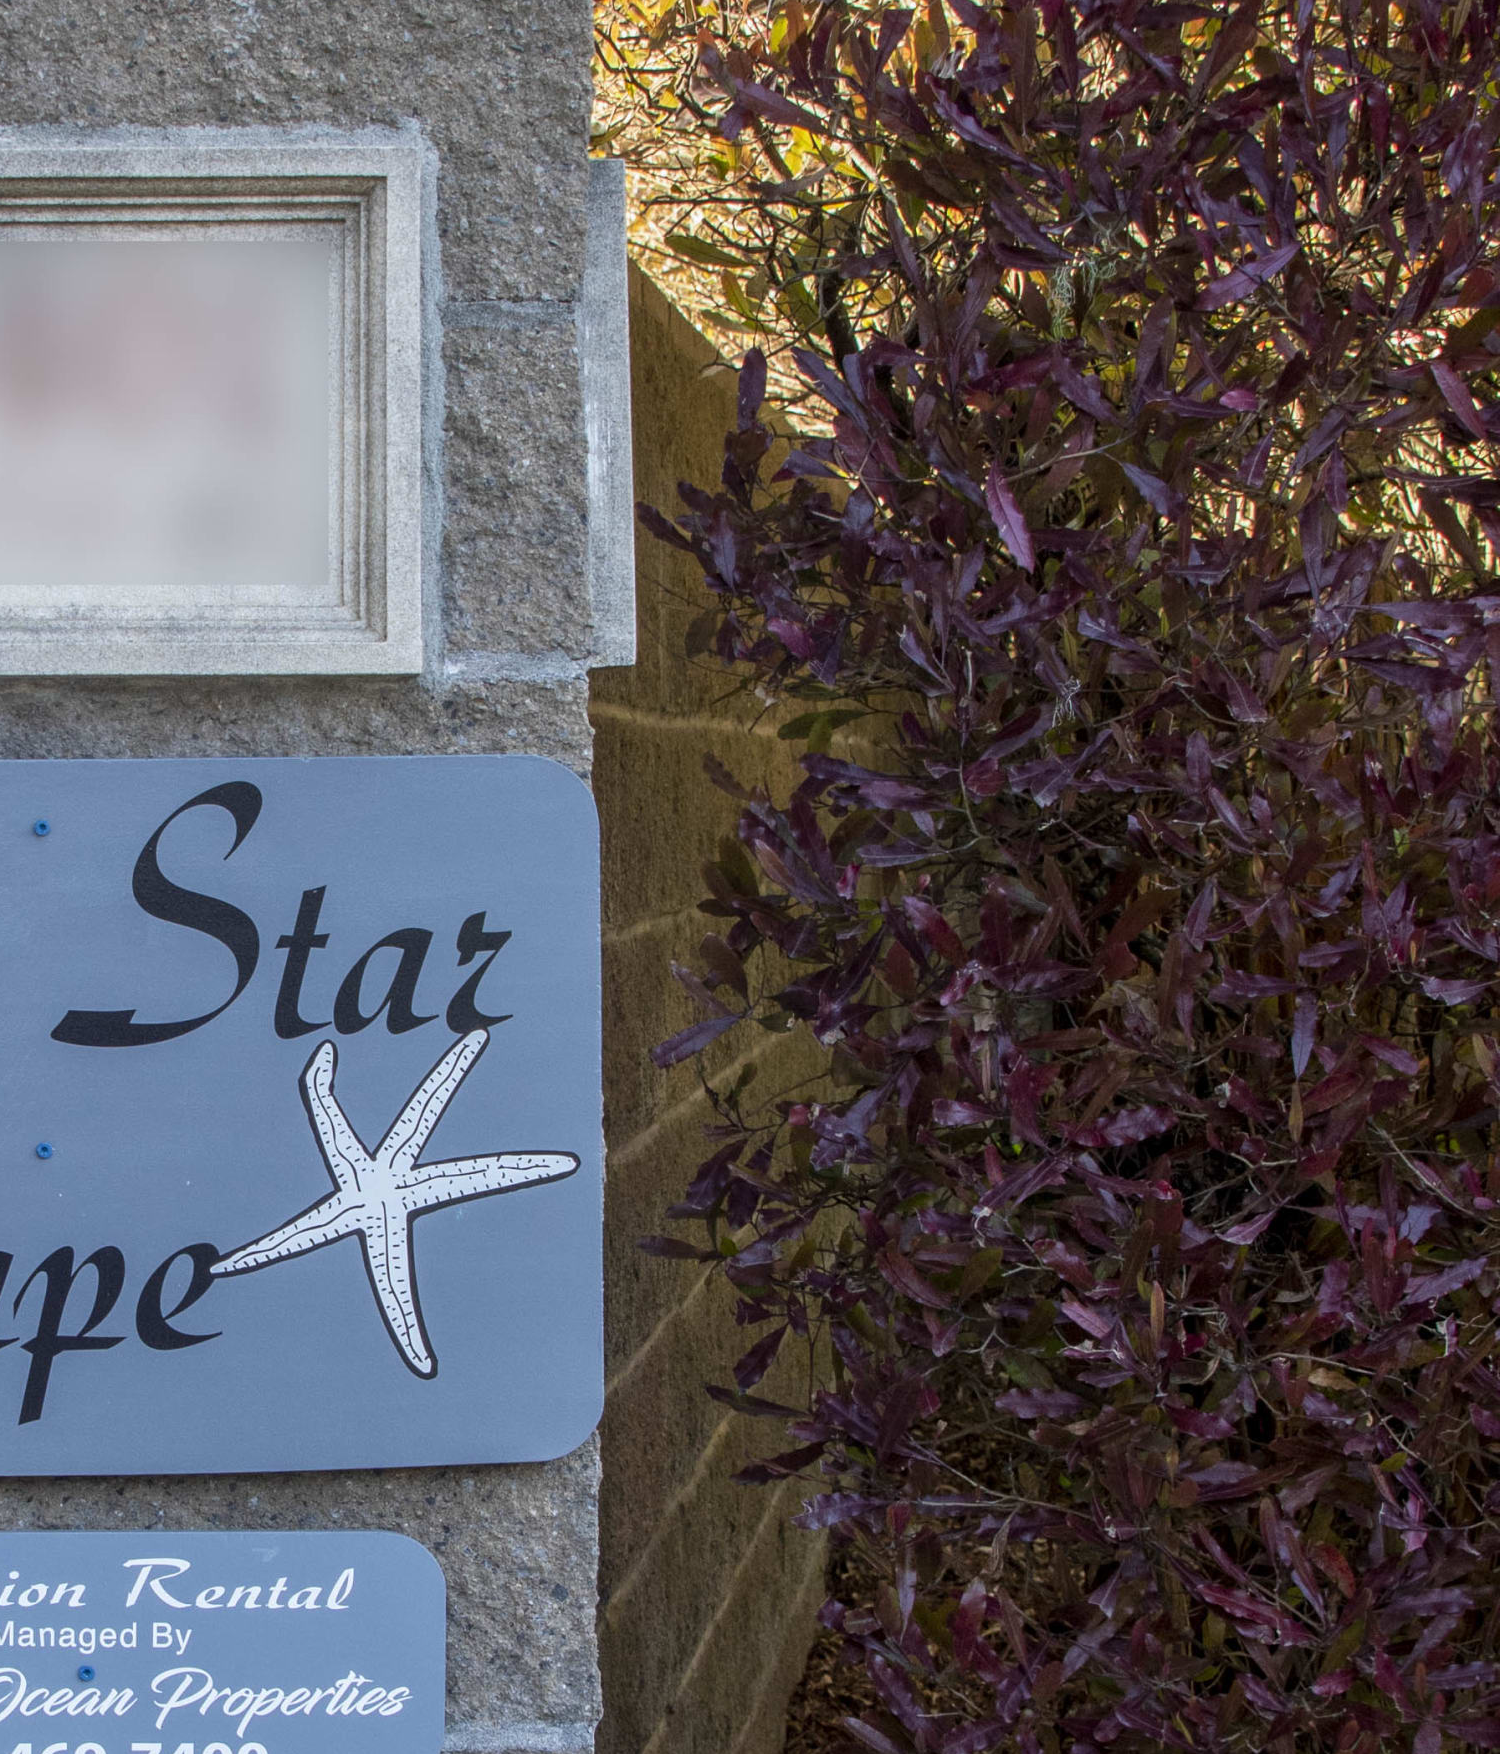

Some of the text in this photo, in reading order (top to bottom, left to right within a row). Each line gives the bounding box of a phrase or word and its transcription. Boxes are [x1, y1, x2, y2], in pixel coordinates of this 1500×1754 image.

[50, 781, 514, 1046] Star
[122, 1557, 355, 1611] Rental
[151, 1621, 193, 1656] By
[150, 1666, 414, 1739] Properties
